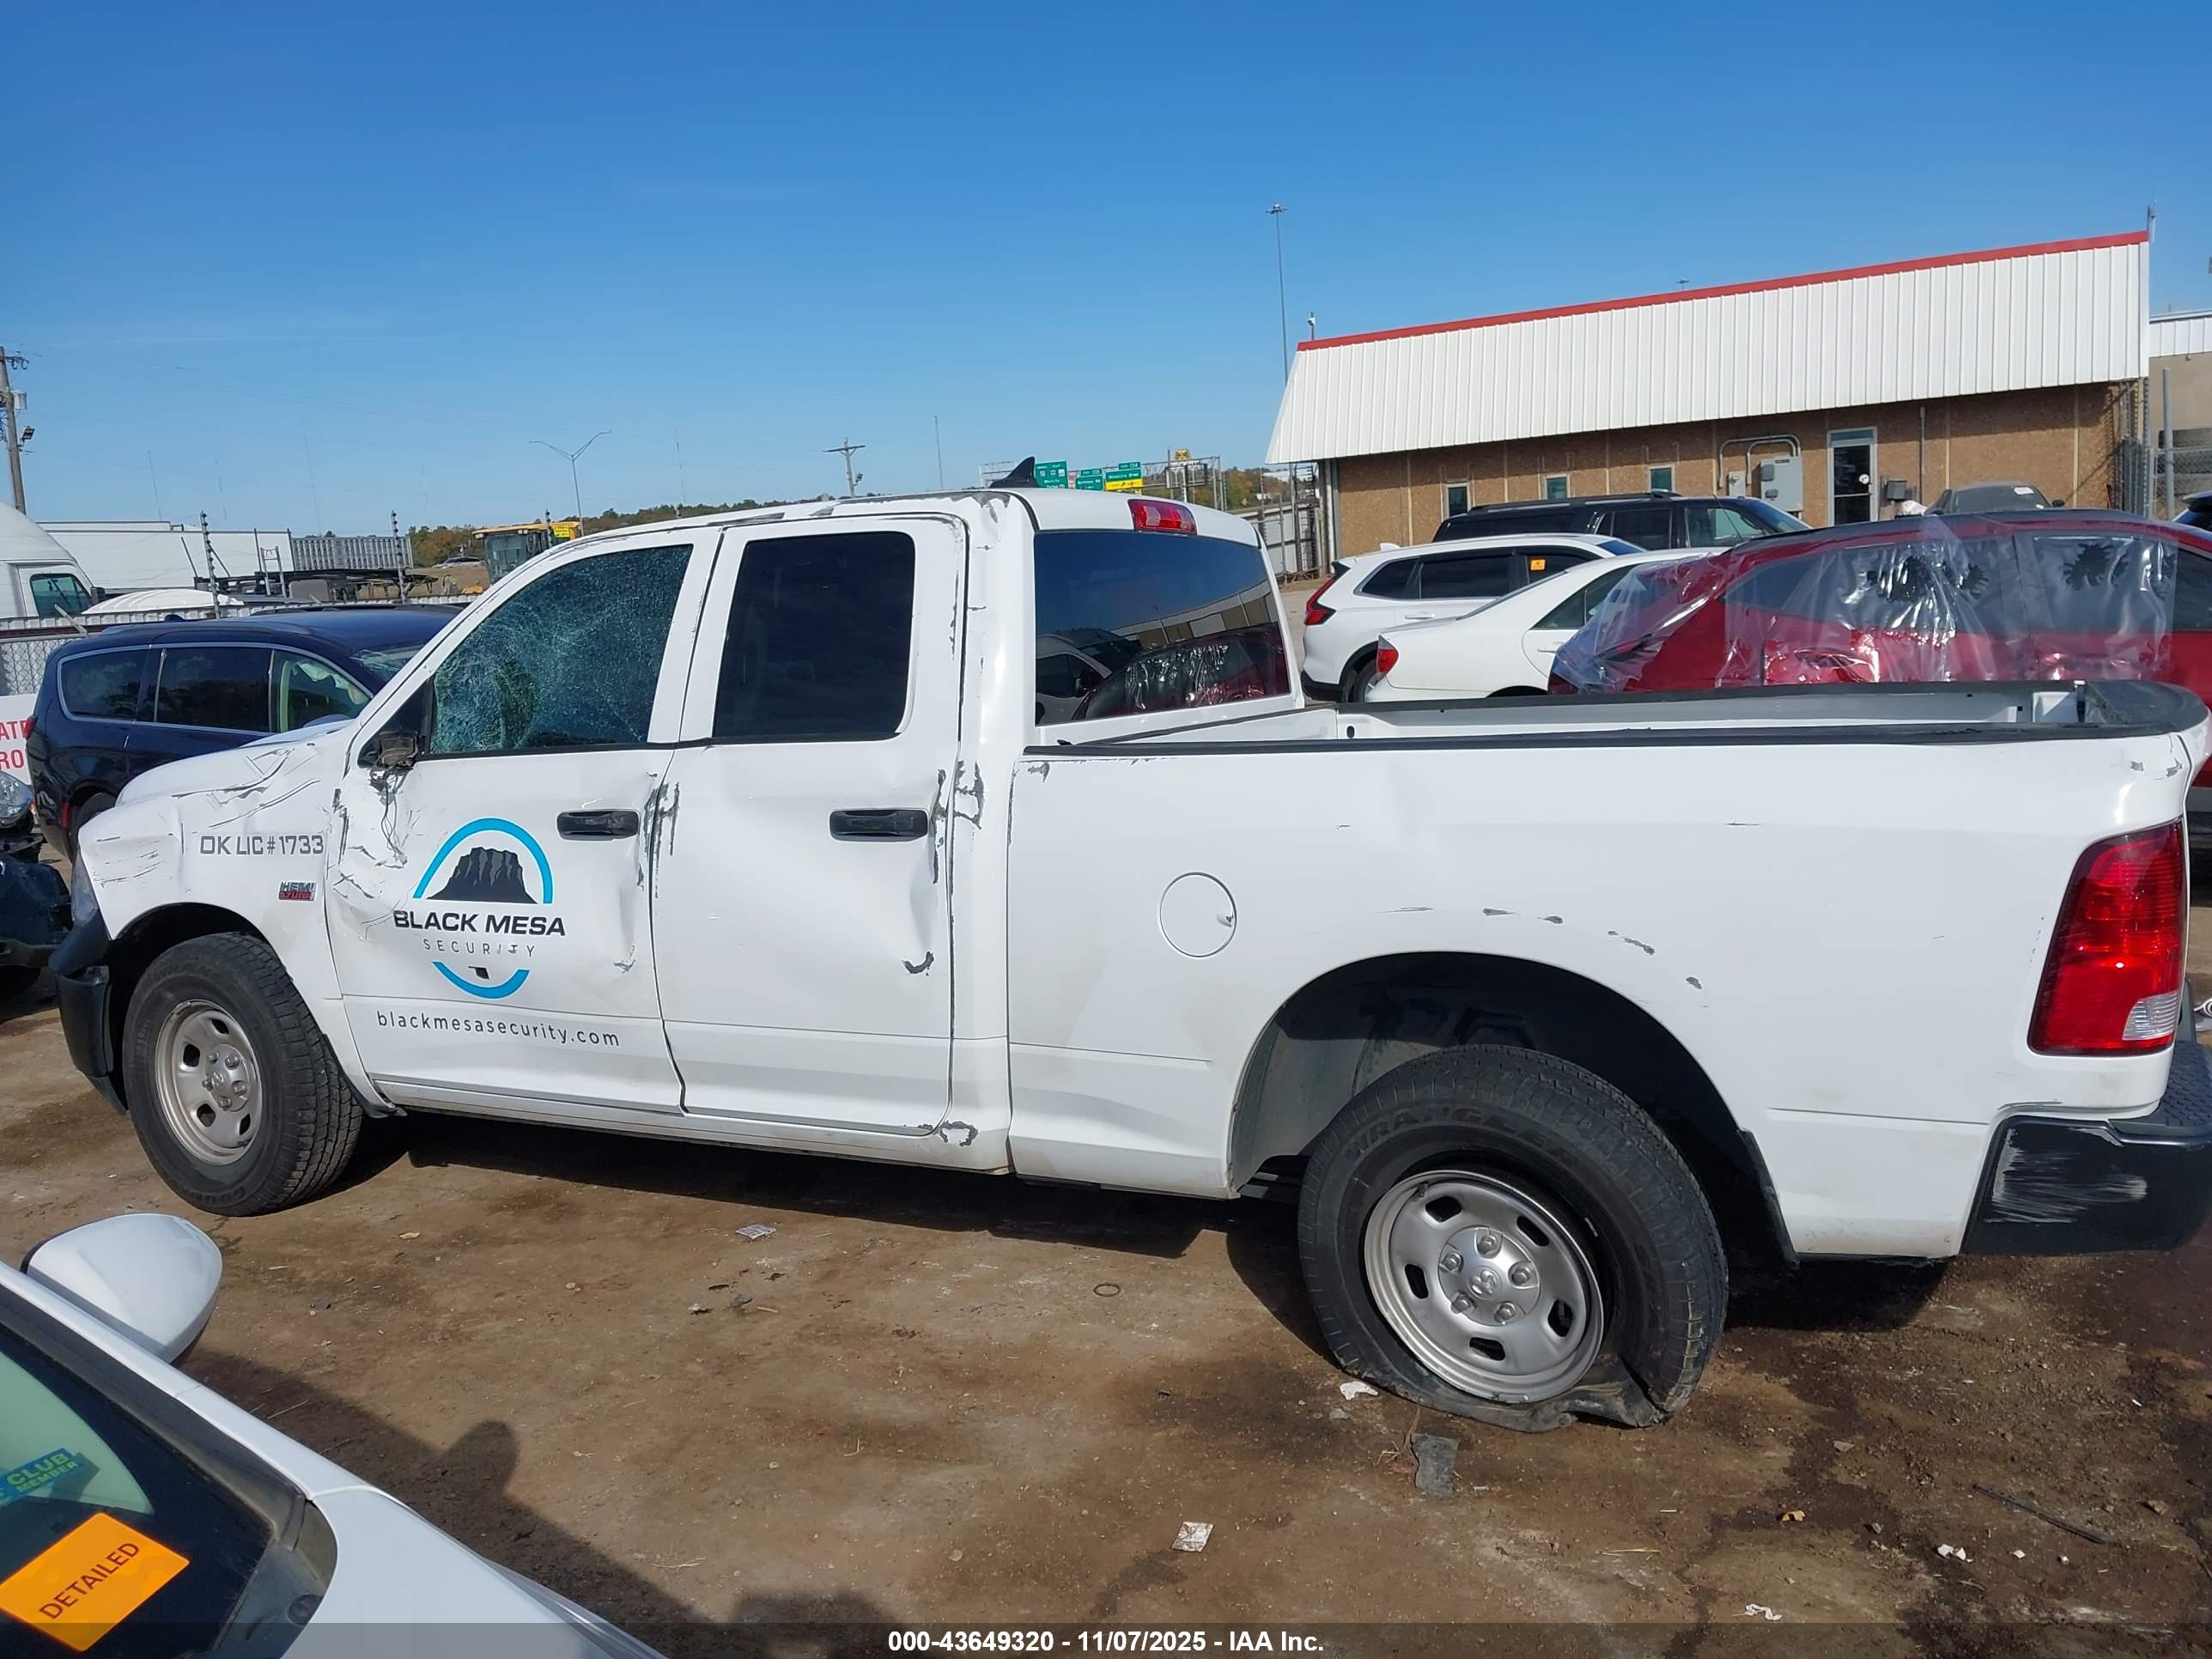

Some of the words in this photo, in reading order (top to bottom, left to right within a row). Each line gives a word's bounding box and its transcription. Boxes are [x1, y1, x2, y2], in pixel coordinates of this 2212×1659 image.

[199, 836, 233, 855] OK
[393, 910, 477, 933] BLACK
[485, 915, 566, 937] MESA
[423, 938, 536, 957] SECURITY
[377, 1010, 619, 1047] blackmesasecurity.com
[6, 1453, 70, 1485] CLUB
[16, 1462, 78, 1493] MEMBER
[39, 1542, 140, 1620] DETAILED
